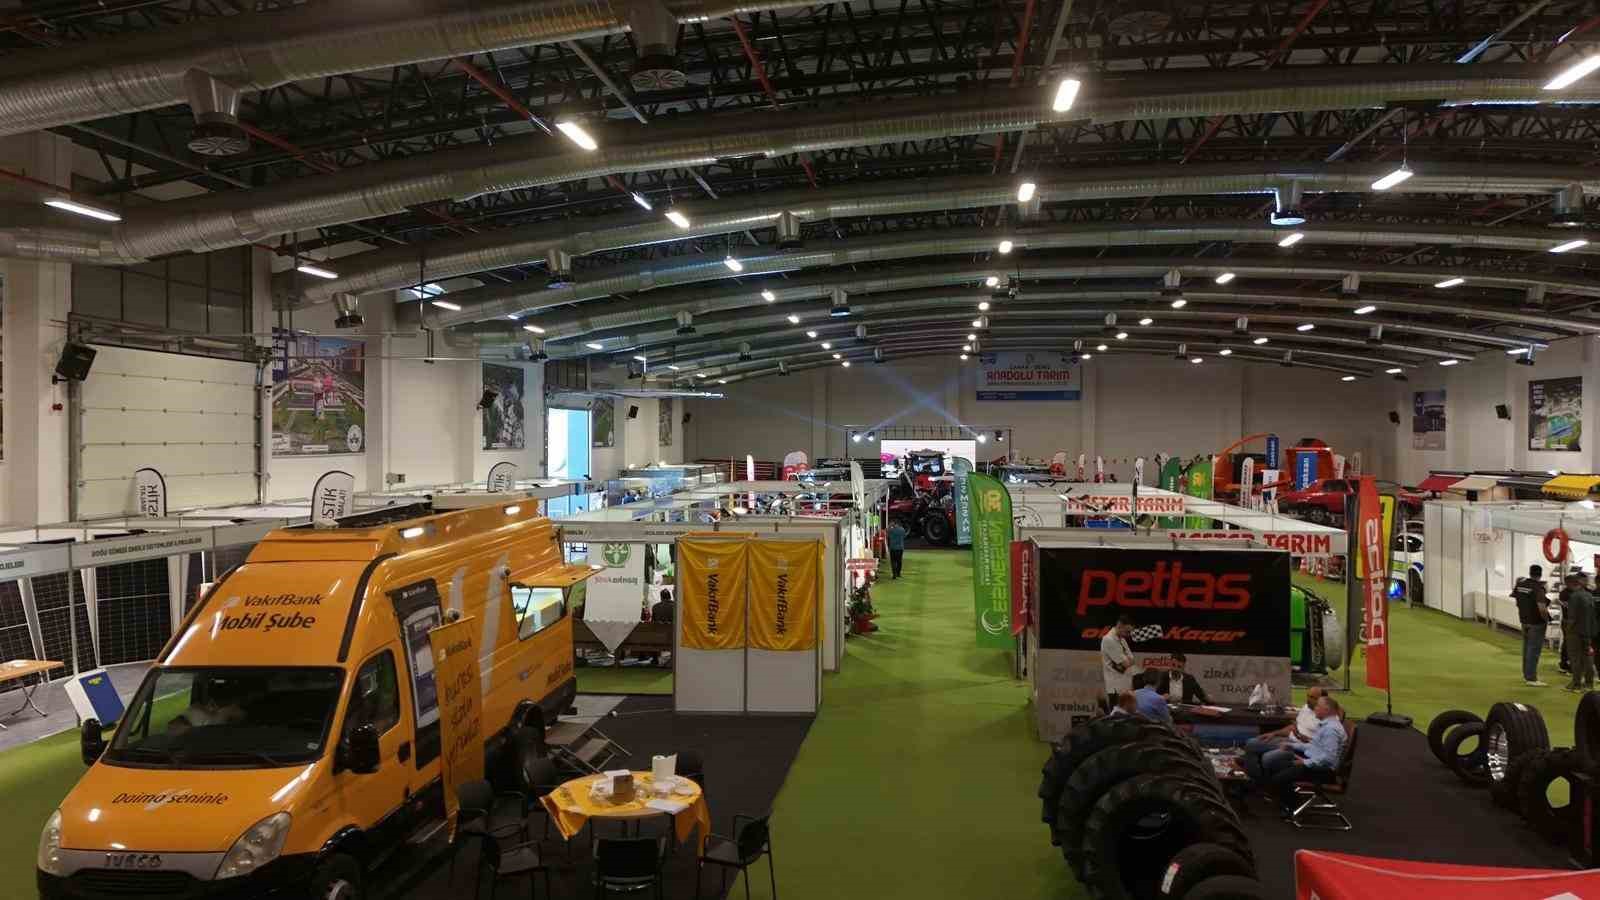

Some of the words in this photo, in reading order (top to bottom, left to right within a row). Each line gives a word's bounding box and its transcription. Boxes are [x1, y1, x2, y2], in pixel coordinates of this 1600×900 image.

[986, 370, 1033, 381] ANADOLU
[1036, 370, 1071, 381] TARIM
[1136, 497, 1184, 512] TARIM
[1263, 533, 1331, 554] TARIM
[1076, 560, 1252, 617] petlas
[243, 593, 324, 607] VakıfBank
[707, 574, 720, 635] VakıfBank
[777, 573, 789, 635] VakıfBank
[263, 611, 316, 633] Şube
[1165, 626, 1247, 643] Kaçar
[112, 792, 166, 804] Daima
[104, 853, 162, 868] IVECO
